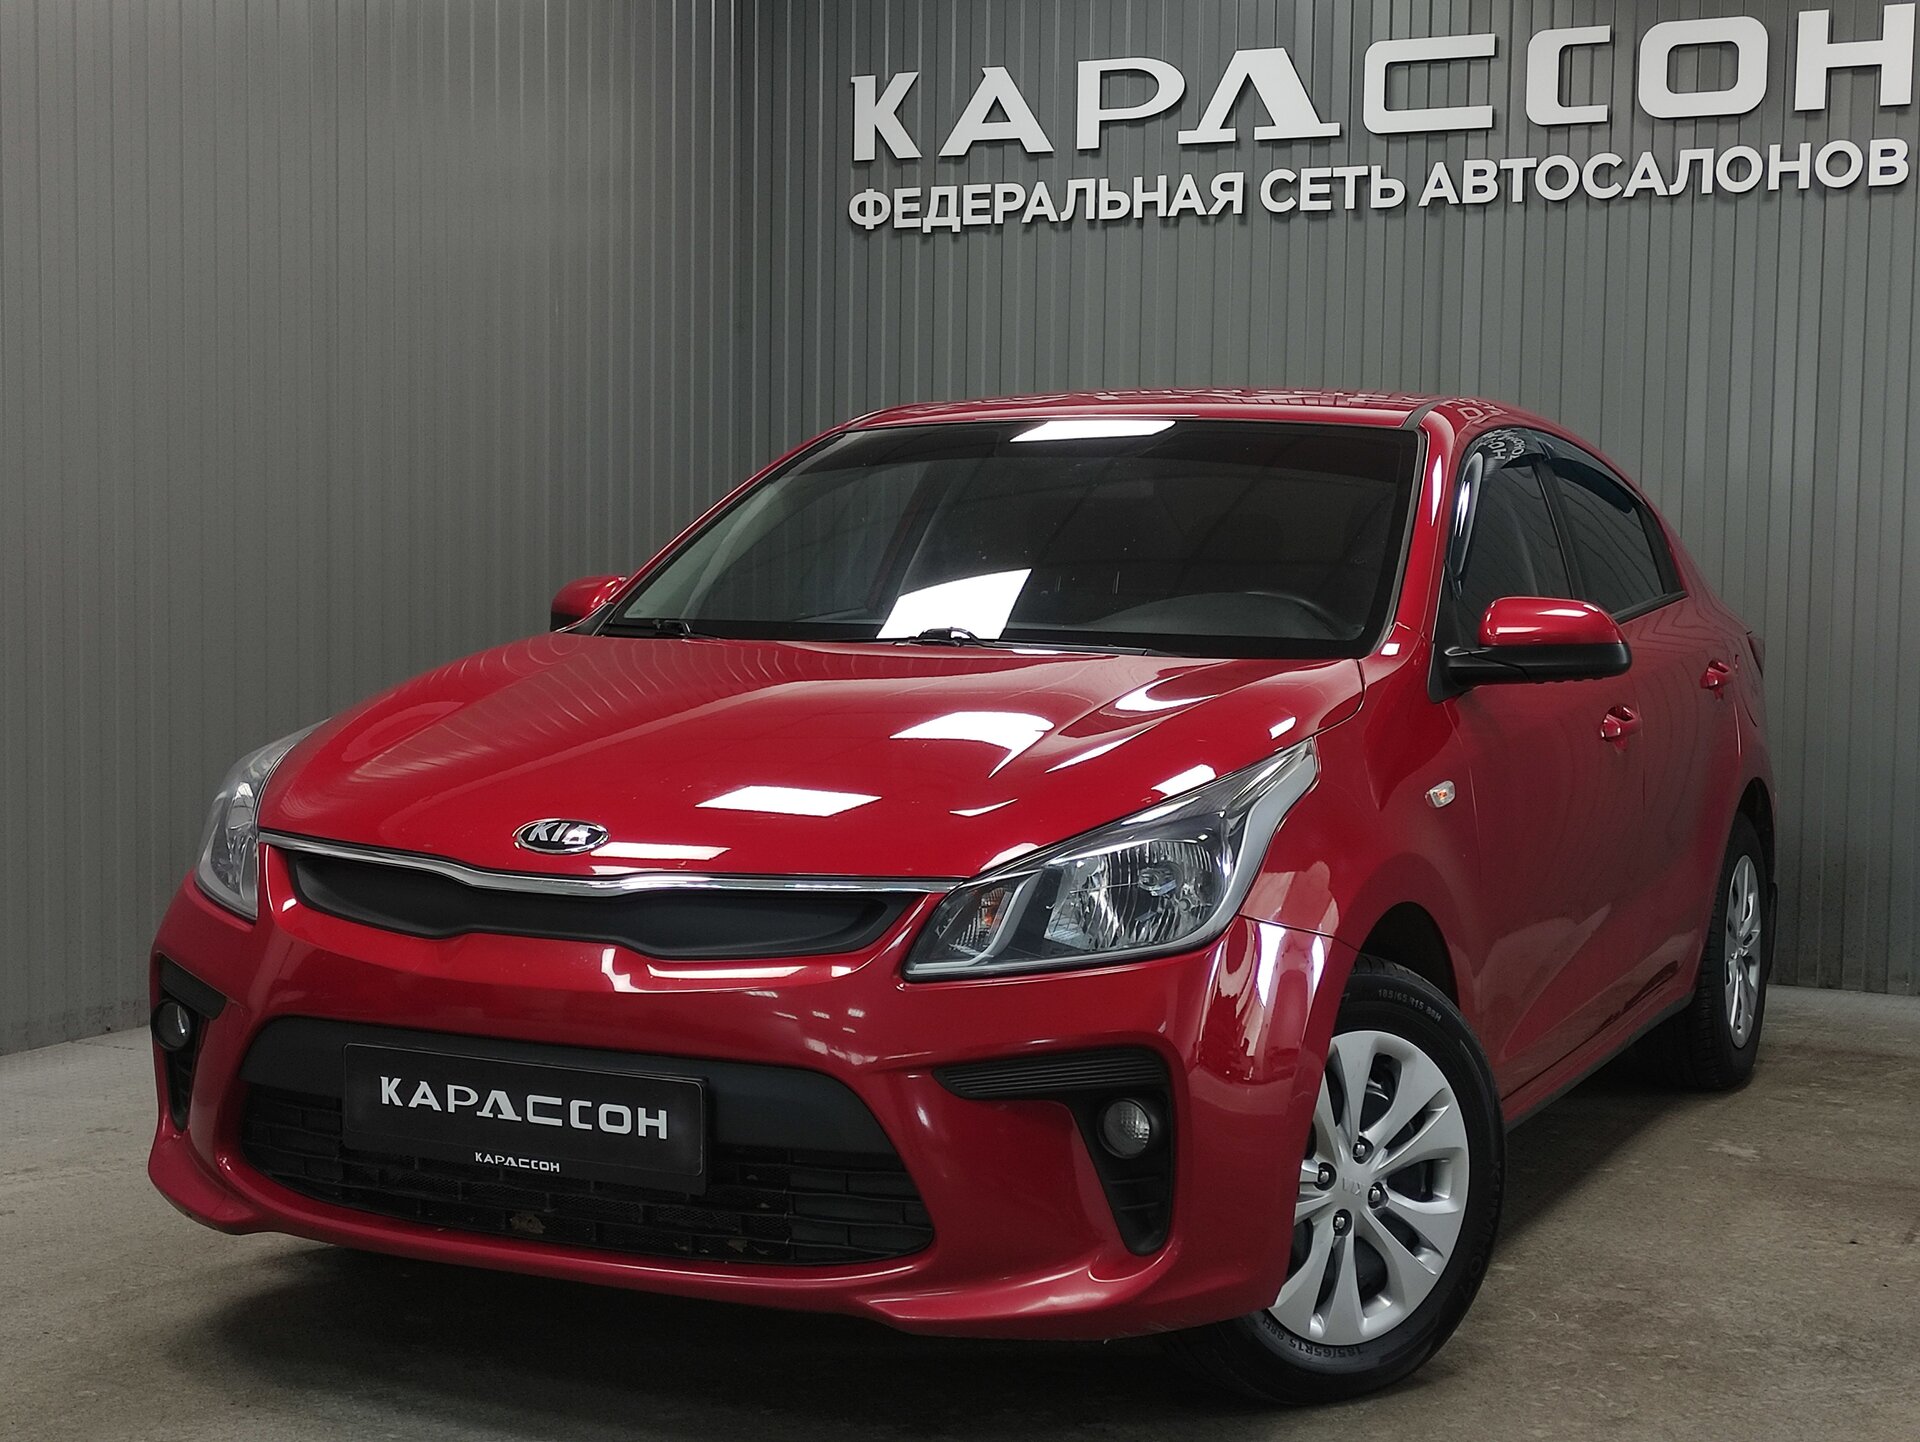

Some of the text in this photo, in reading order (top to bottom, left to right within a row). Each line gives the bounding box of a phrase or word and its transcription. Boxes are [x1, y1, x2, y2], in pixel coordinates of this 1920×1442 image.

[849, 138, 1909, 234] ФЕДЕРАЛЬНАЯ СЕТЬ АВТОСАЛОНОВ
[527, 821, 592, 846] KIA
[1288, 1336, 1366, 1360] 185/65R15
